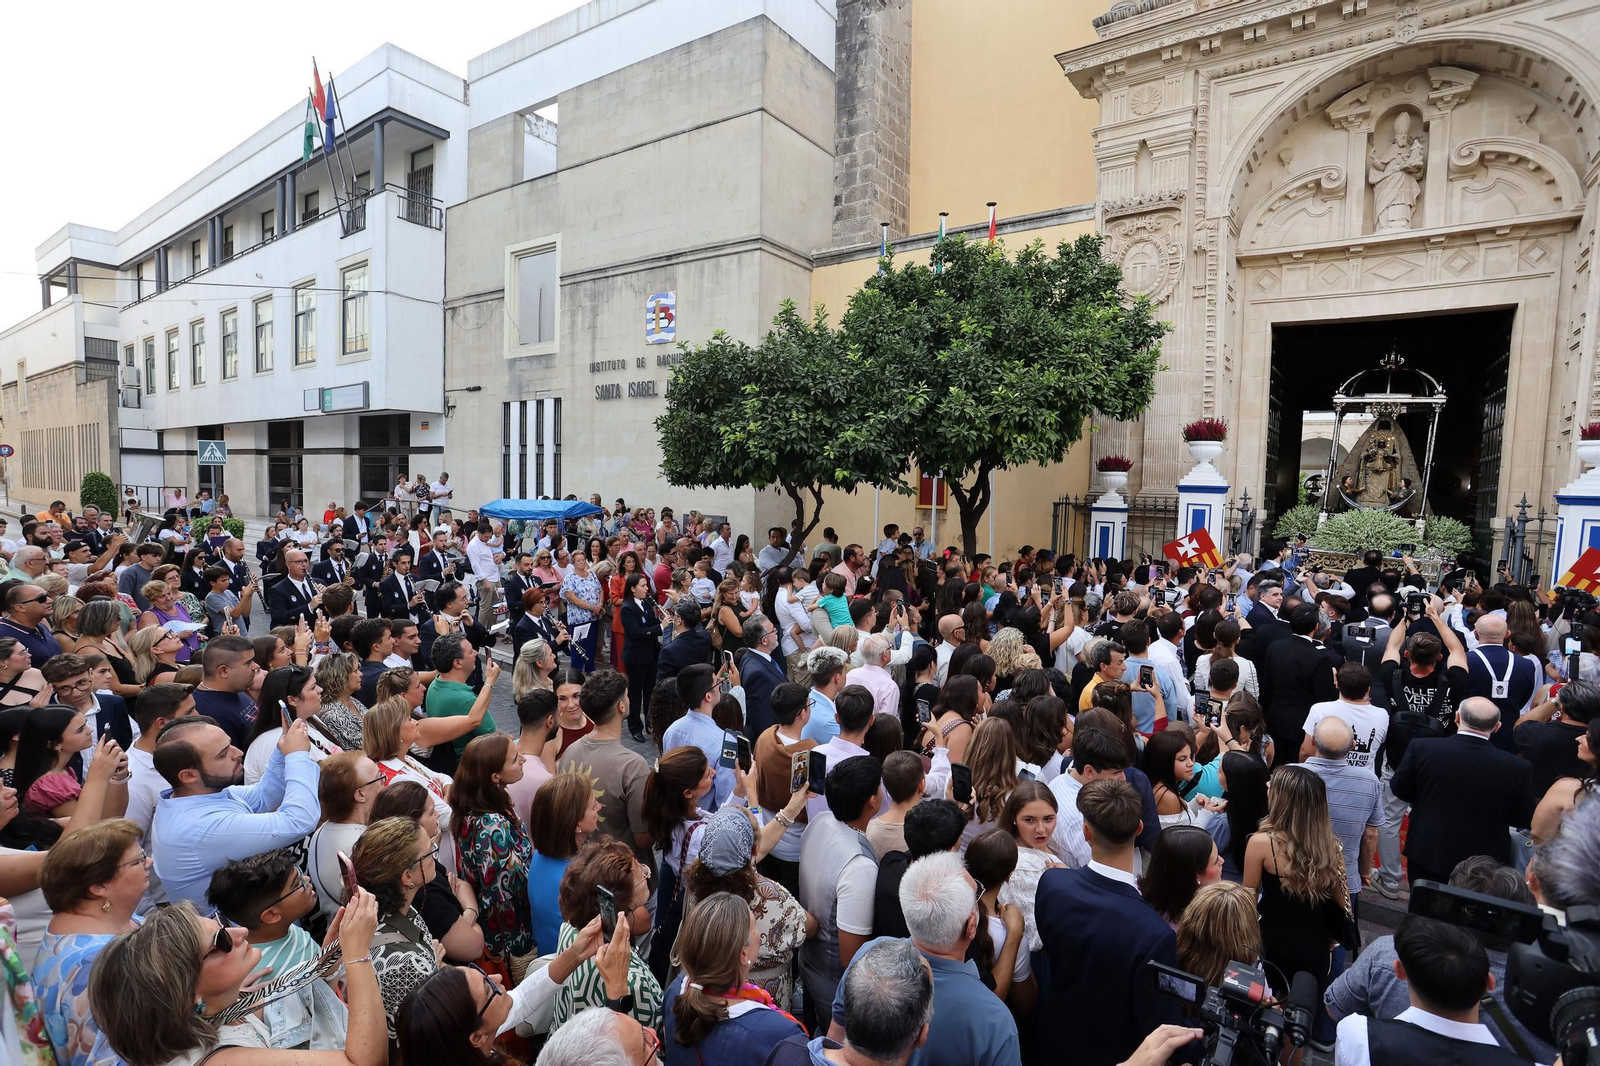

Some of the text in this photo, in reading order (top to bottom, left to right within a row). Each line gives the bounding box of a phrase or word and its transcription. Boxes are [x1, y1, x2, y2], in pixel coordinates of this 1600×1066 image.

[589, 359, 626, 373] INSTITUTO
[636, 356, 645, 368] DE
[595, 383, 621, 400] SANTA
[628, 380, 658, 398] ISABEL
